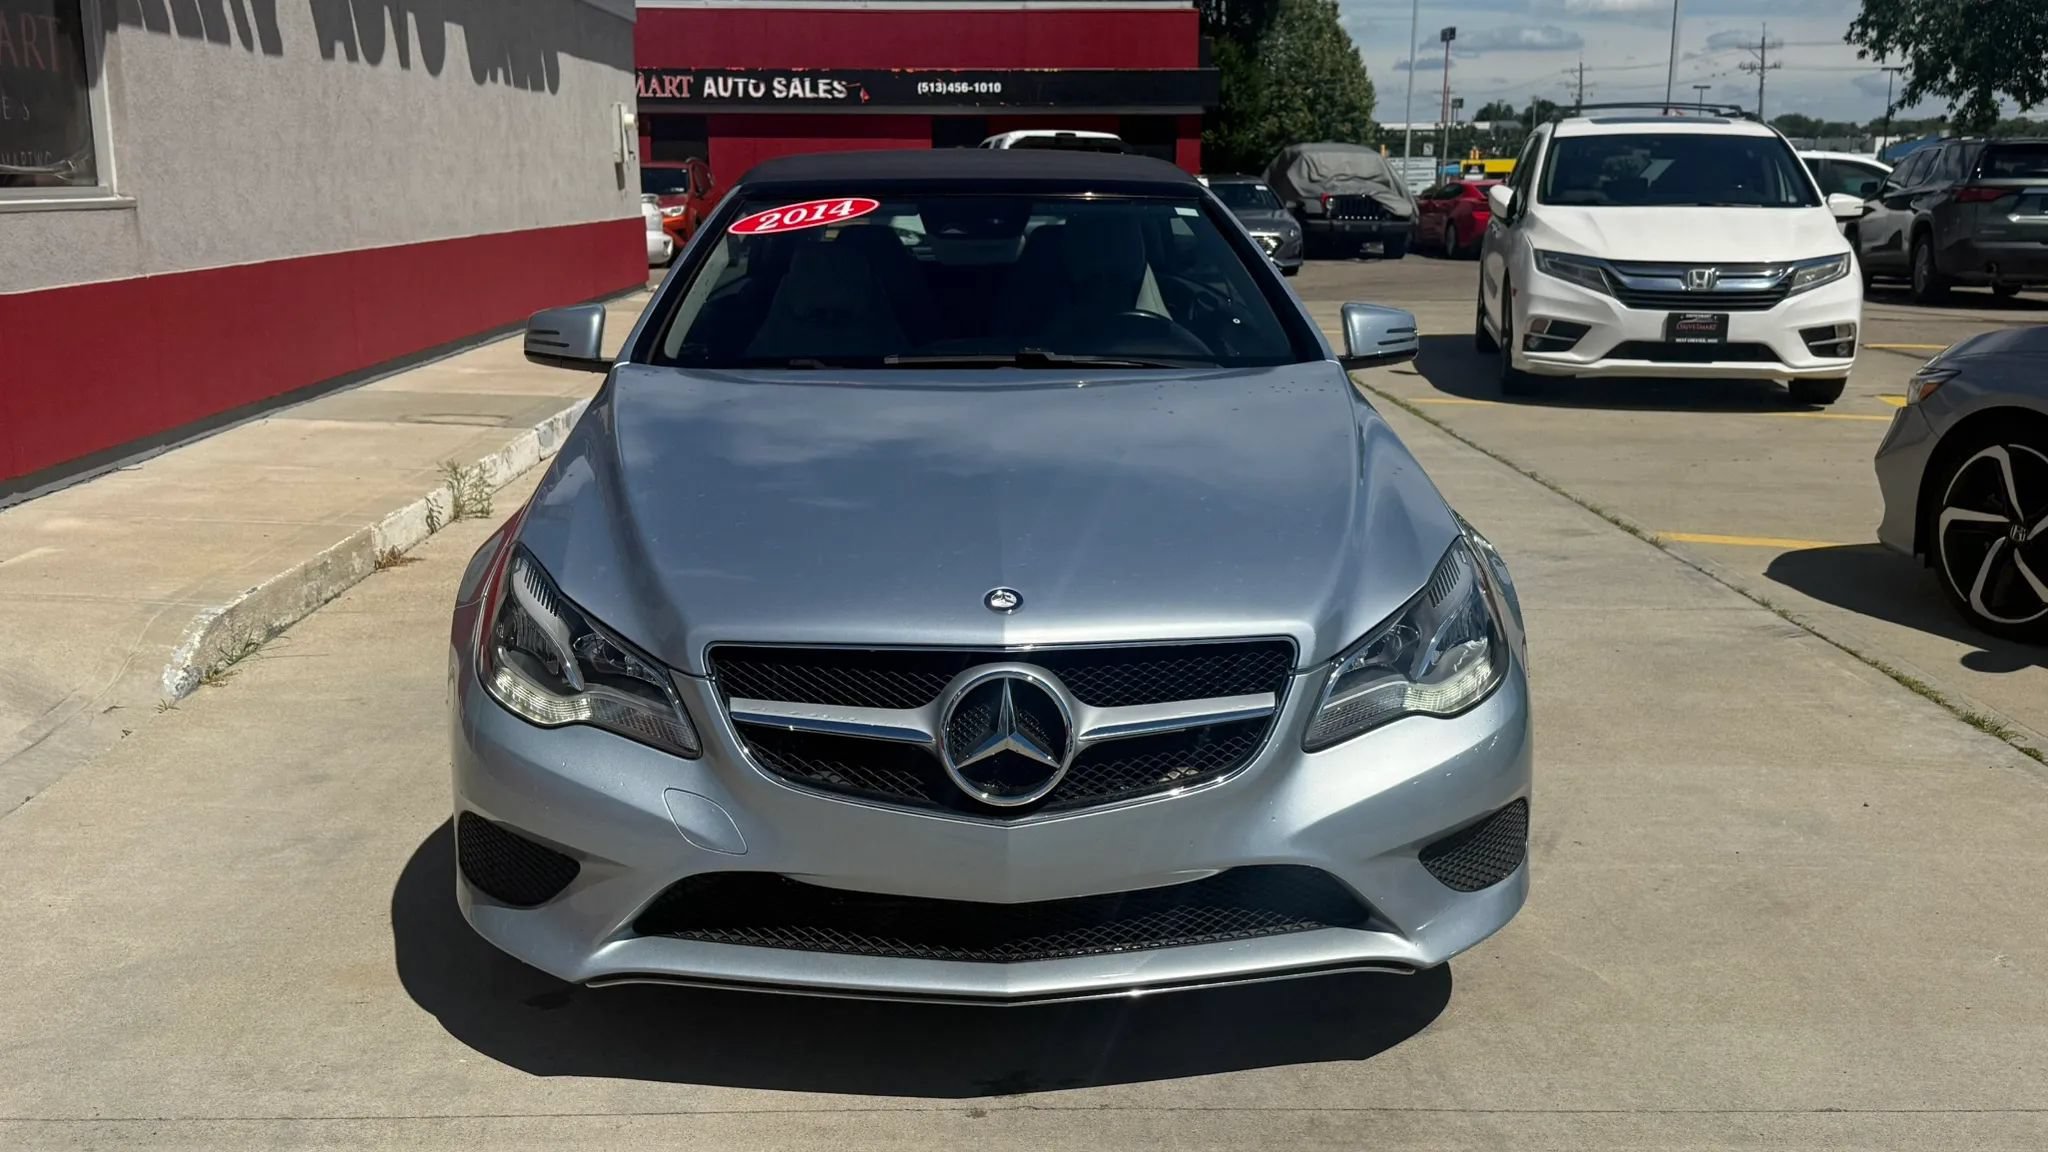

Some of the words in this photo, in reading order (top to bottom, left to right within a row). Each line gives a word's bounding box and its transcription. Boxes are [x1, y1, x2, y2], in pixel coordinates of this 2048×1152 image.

[703, 76, 765, 98] AUTO
[772, 77, 848, 99] SALES
[917, 82, 1002, 95] (513)456-1010
[754, 200, 855, 232] 2014
